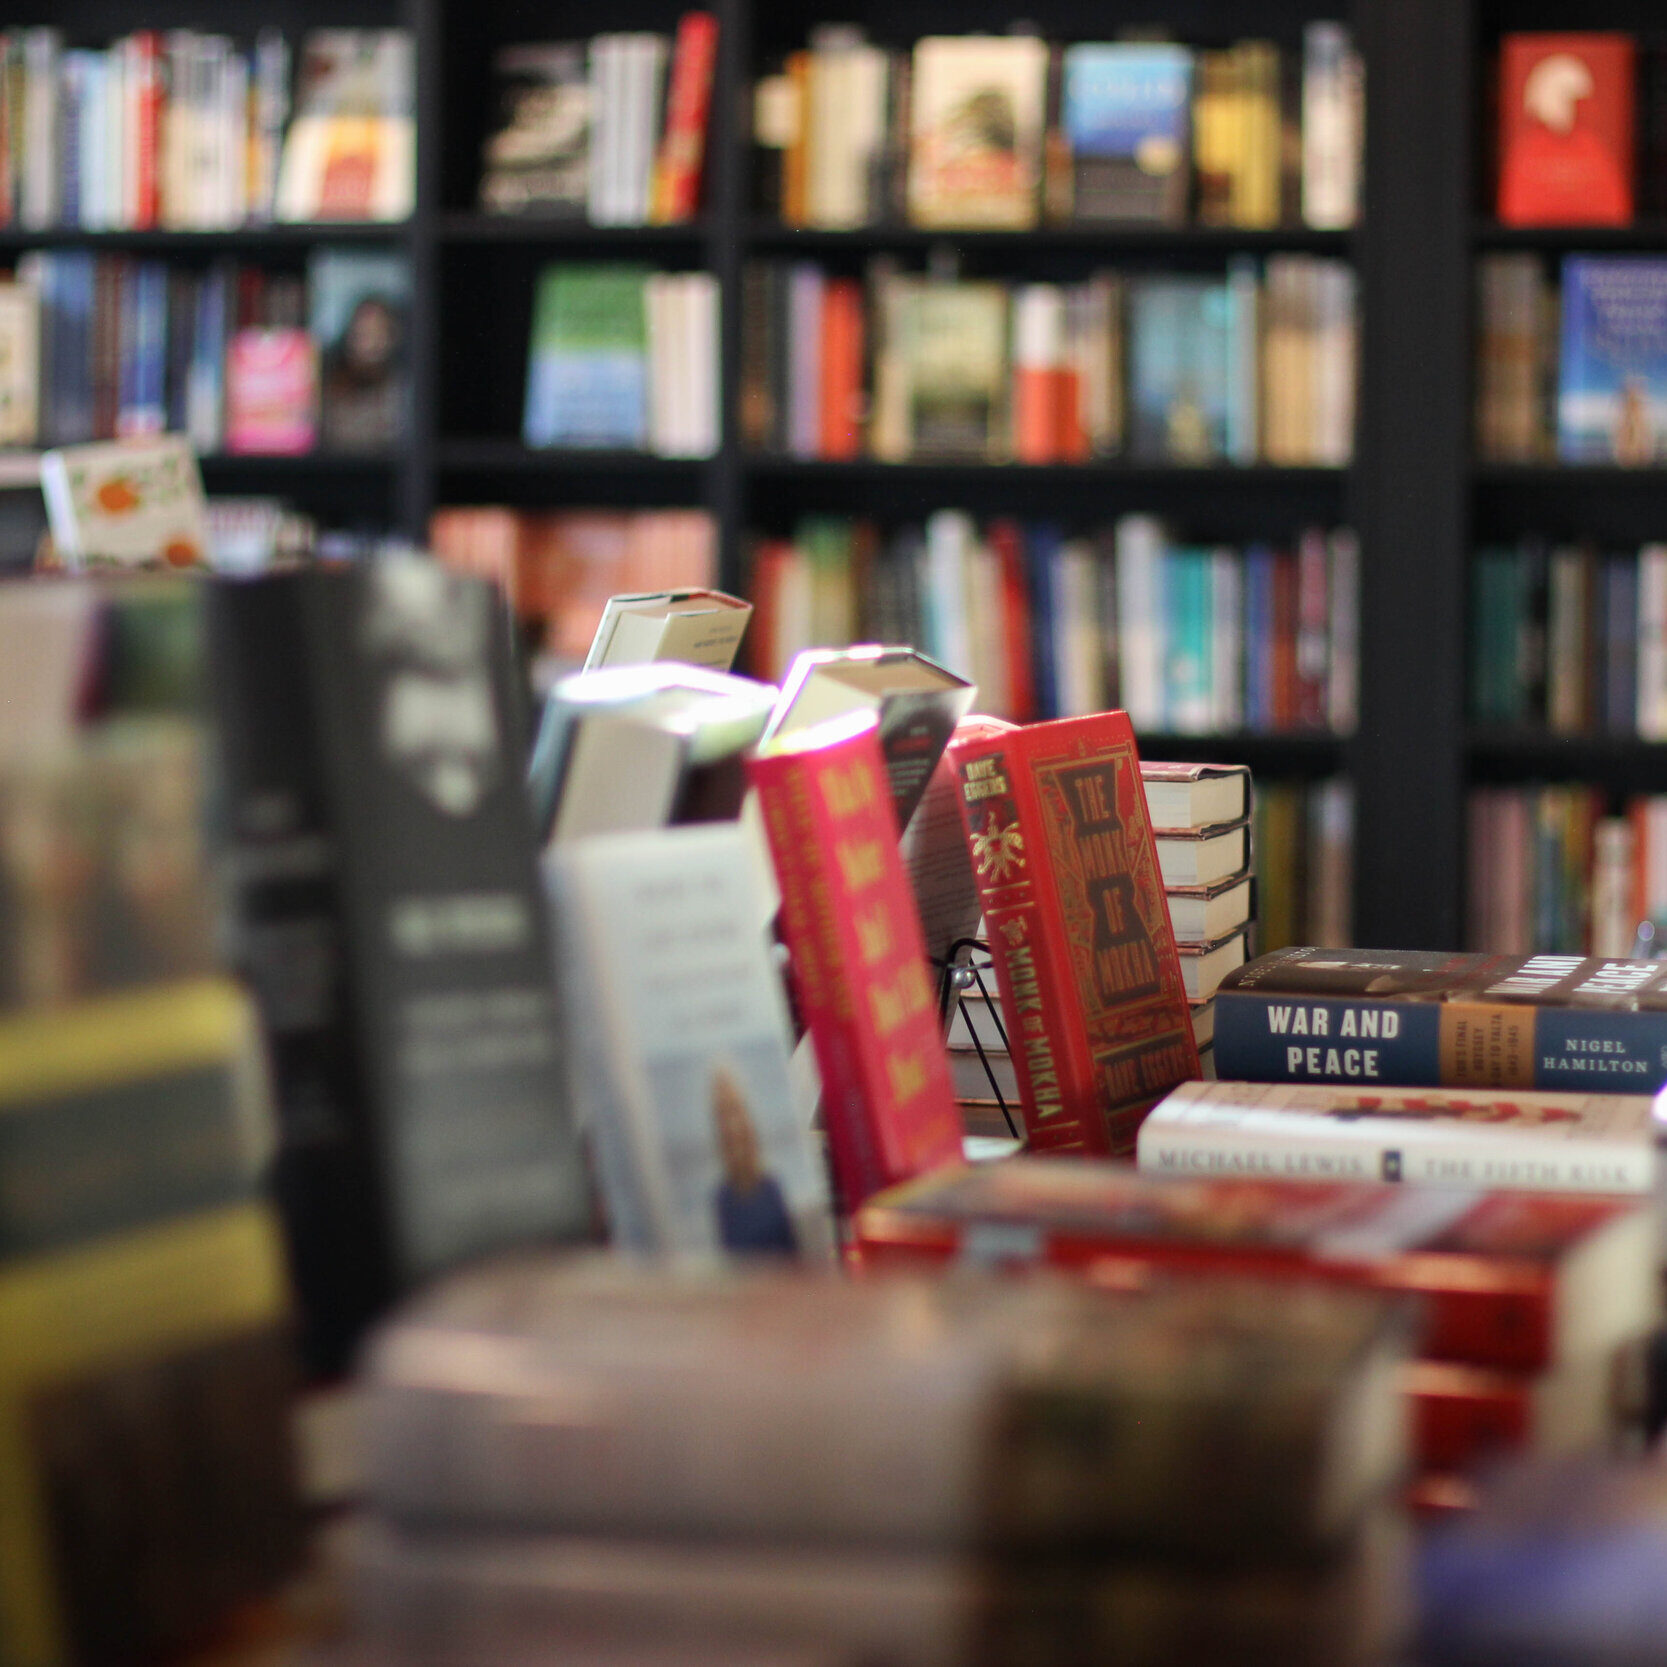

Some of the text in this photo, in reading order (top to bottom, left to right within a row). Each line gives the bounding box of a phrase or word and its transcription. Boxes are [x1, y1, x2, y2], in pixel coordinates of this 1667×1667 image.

[1075, 775, 1109, 822] THE
[1102, 887, 1124, 934] OF
[1517, 955, 1587, 977] AND
[1572, 963, 1659, 994] PEACE
[1005, 946, 1042, 1014] MONK
[1024, 1036, 1063, 1119] MOKHA
[1267, 1005, 1399, 1039] WAR AND
[1287, 1046, 1379, 1077] PEACE
[1565, 1039, 1626, 1054] NIGEL
[1543, 1056, 1648, 1073] HAMILTON
[1159, 1150, 1364, 1173] MICHAEL LEWIS
[1425, 1157, 1471, 1178] THE
